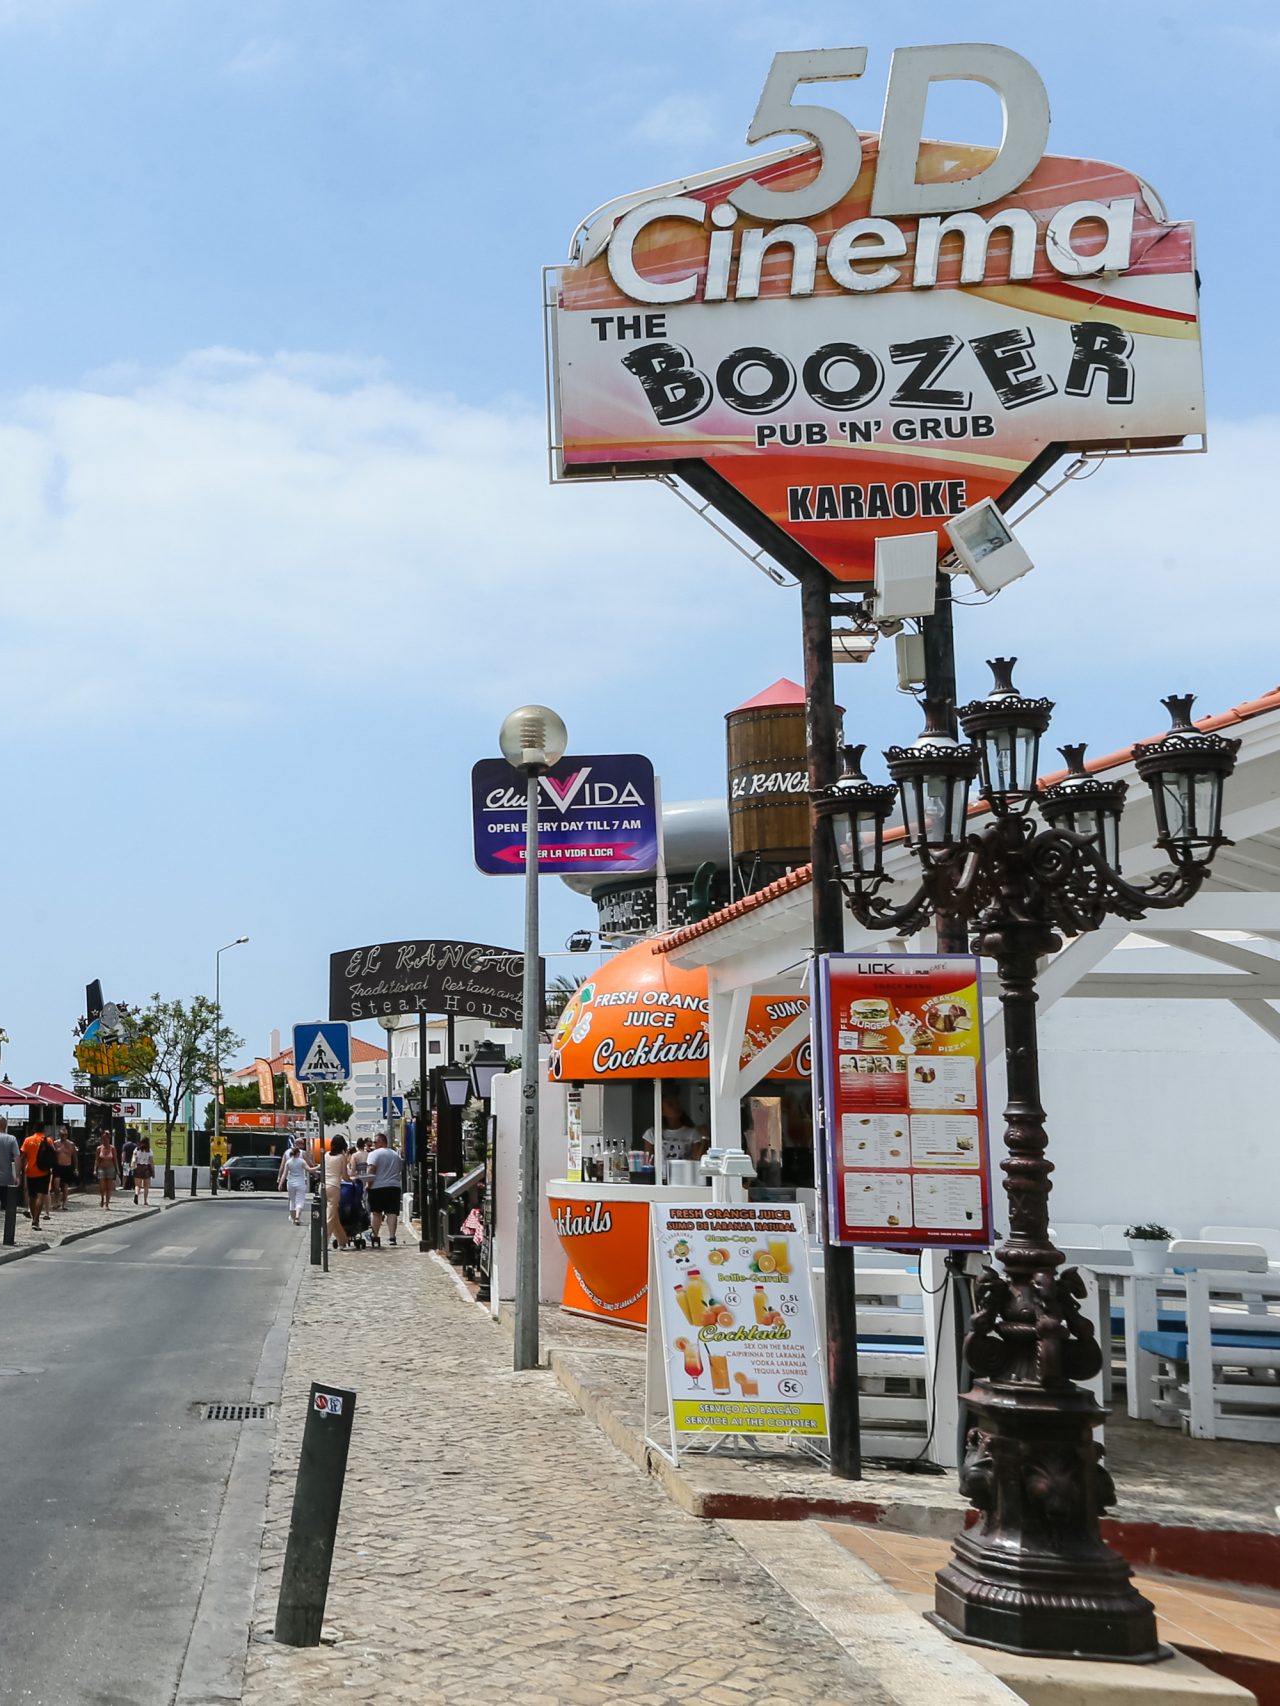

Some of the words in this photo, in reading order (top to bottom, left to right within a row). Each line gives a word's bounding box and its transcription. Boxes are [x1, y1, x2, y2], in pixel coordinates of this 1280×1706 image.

[726, 42, 1051, 221] 5D
[606, 196, 1137, 305] Cinema
[591, 312, 667, 341] THE
[621, 321, 1135, 426] BOOZER
[756, 422, 828, 447] PUB
[890, 414, 995, 441] GRUB
[788, 480, 968, 523] KARAOKE
[537, 767, 645, 814] VIDA
[731, 776, 747, 799] EL
[487, 822, 519, 833] OPEN
[522, 822, 559, 832] EERY
[560, 821, 585, 831] DAY
[586, 820, 610, 830] TILL
[612, 820, 618, 830] 7
[622, 820, 641, 829] AM
[519, 850, 548, 859] EER
[550, 849, 562, 858] LA
[565, 848, 587, 858] VIDA
[589, 848, 613, 857] LOCA
[345, 945, 382, 978] EL
[858, 963, 895, 975] LICK
[349, 974, 429, 999] Traditional
[351, 994, 428, 1018] Steak
[444, 994, 524, 1022] House
[593, 990, 639, 1008] FRESH
[643, 990, 709, 1014] ORANG
[765, 1000, 809, 1020] SUMO
[623, 1011, 676, 1028] JUICE
[592, 1031, 709, 1073] Cocktails
[670, 1209, 702, 1219] FRESH
[704, 1209, 756, 1220] ORANGE
[757, 1210, 791, 1221] JUICE
[666, 1221, 695, 1231] SUMO
[696, 1221, 709, 1231] DE
[710, 1222, 753, 1232] LARANJA
[754, 1222, 796, 1233] NATURAL
[784, 1304, 796, 1314] 3€
[698, 1324, 791, 1342] Cocktails
[782, 1368, 808, 1376] SUNRISE
[784, 1381, 798, 1393] 5€
[699, 1405, 740, 1415] SERVIÇO
[742, 1405, 758, 1414] AO
[760, 1405, 800, 1414] BALCÃO
[685, 1416, 727, 1425] SERVICE
[731, 1417, 745, 1425] AT
[746, 1418, 764, 1426] THE
[767, 1419, 817, 1428] COUNTER
